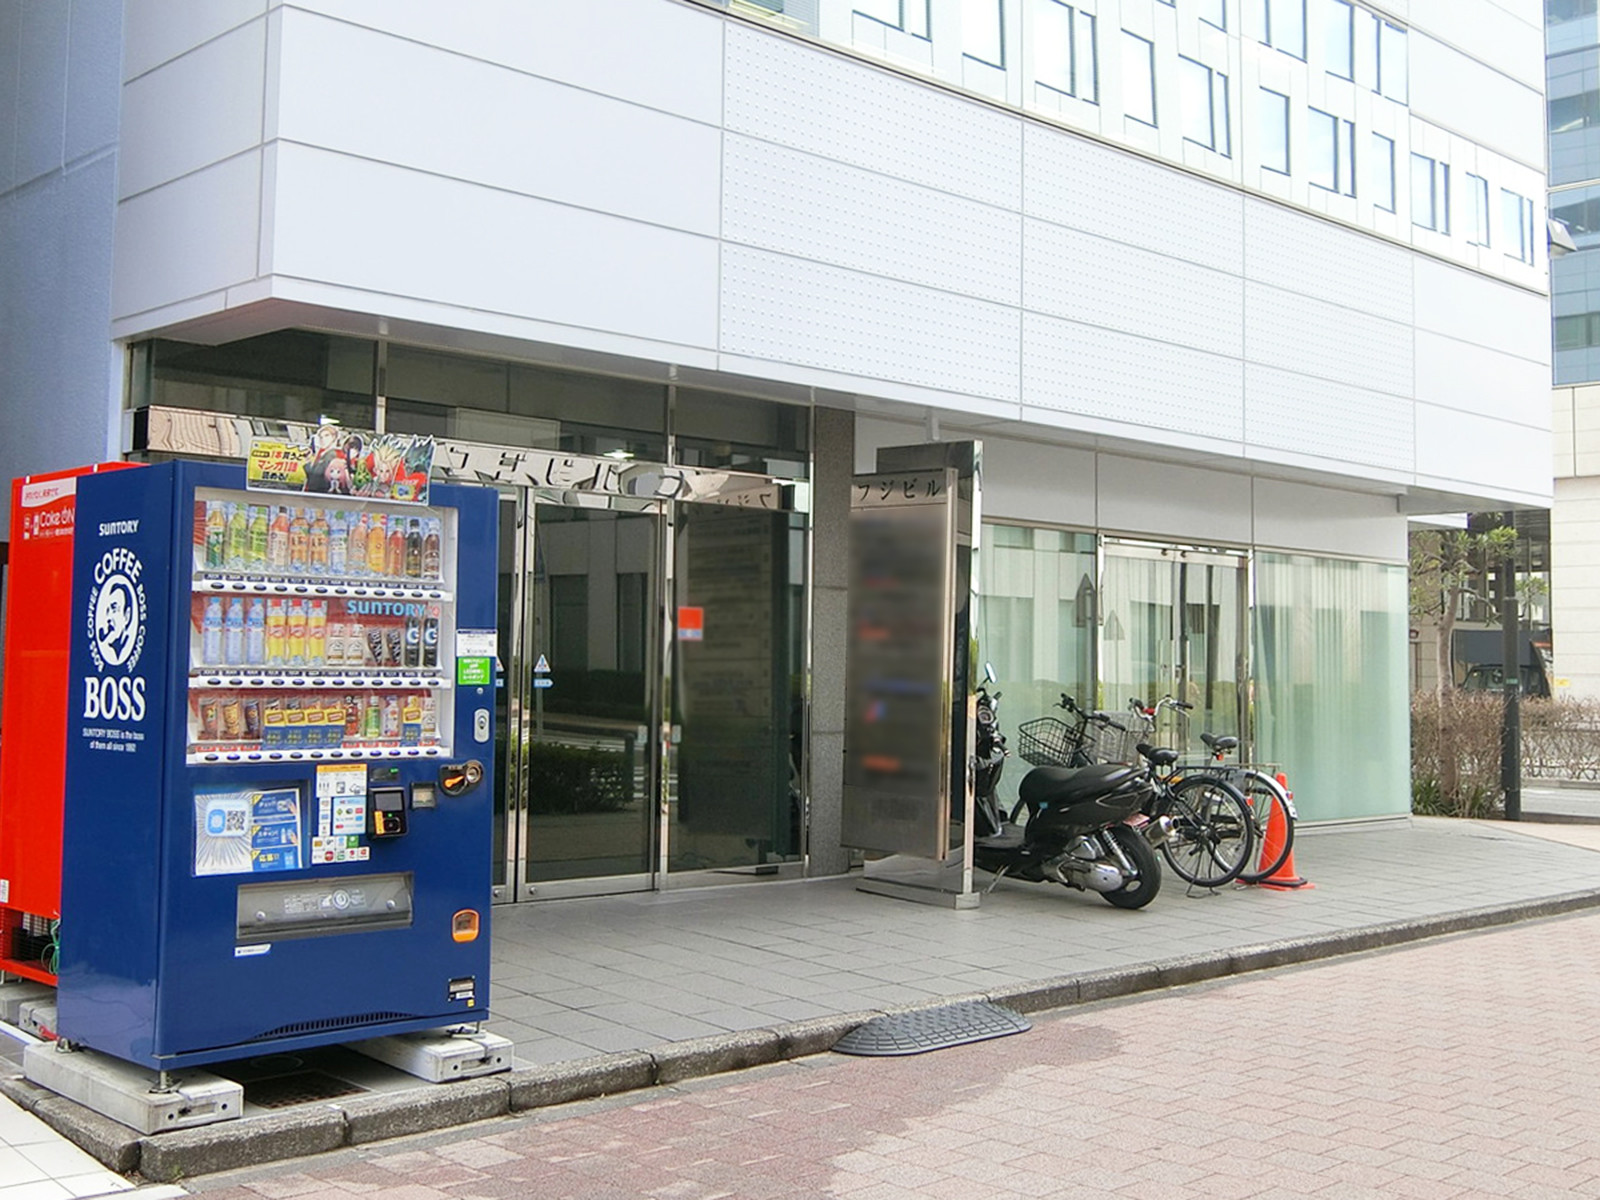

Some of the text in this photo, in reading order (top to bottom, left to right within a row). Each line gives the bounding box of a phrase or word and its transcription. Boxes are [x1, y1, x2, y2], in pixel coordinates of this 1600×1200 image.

[858, 478, 941, 501] フジビル
[40, 511, 61, 527] Coke
[98, 519, 140, 536] SUNTORY
[94, 547, 143, 585] COFFEE
[87, 586, 99, 639] COFFEE
[347, 599, 426, 617] SUNTORY
[83, 676, 146, 721] BOSS
